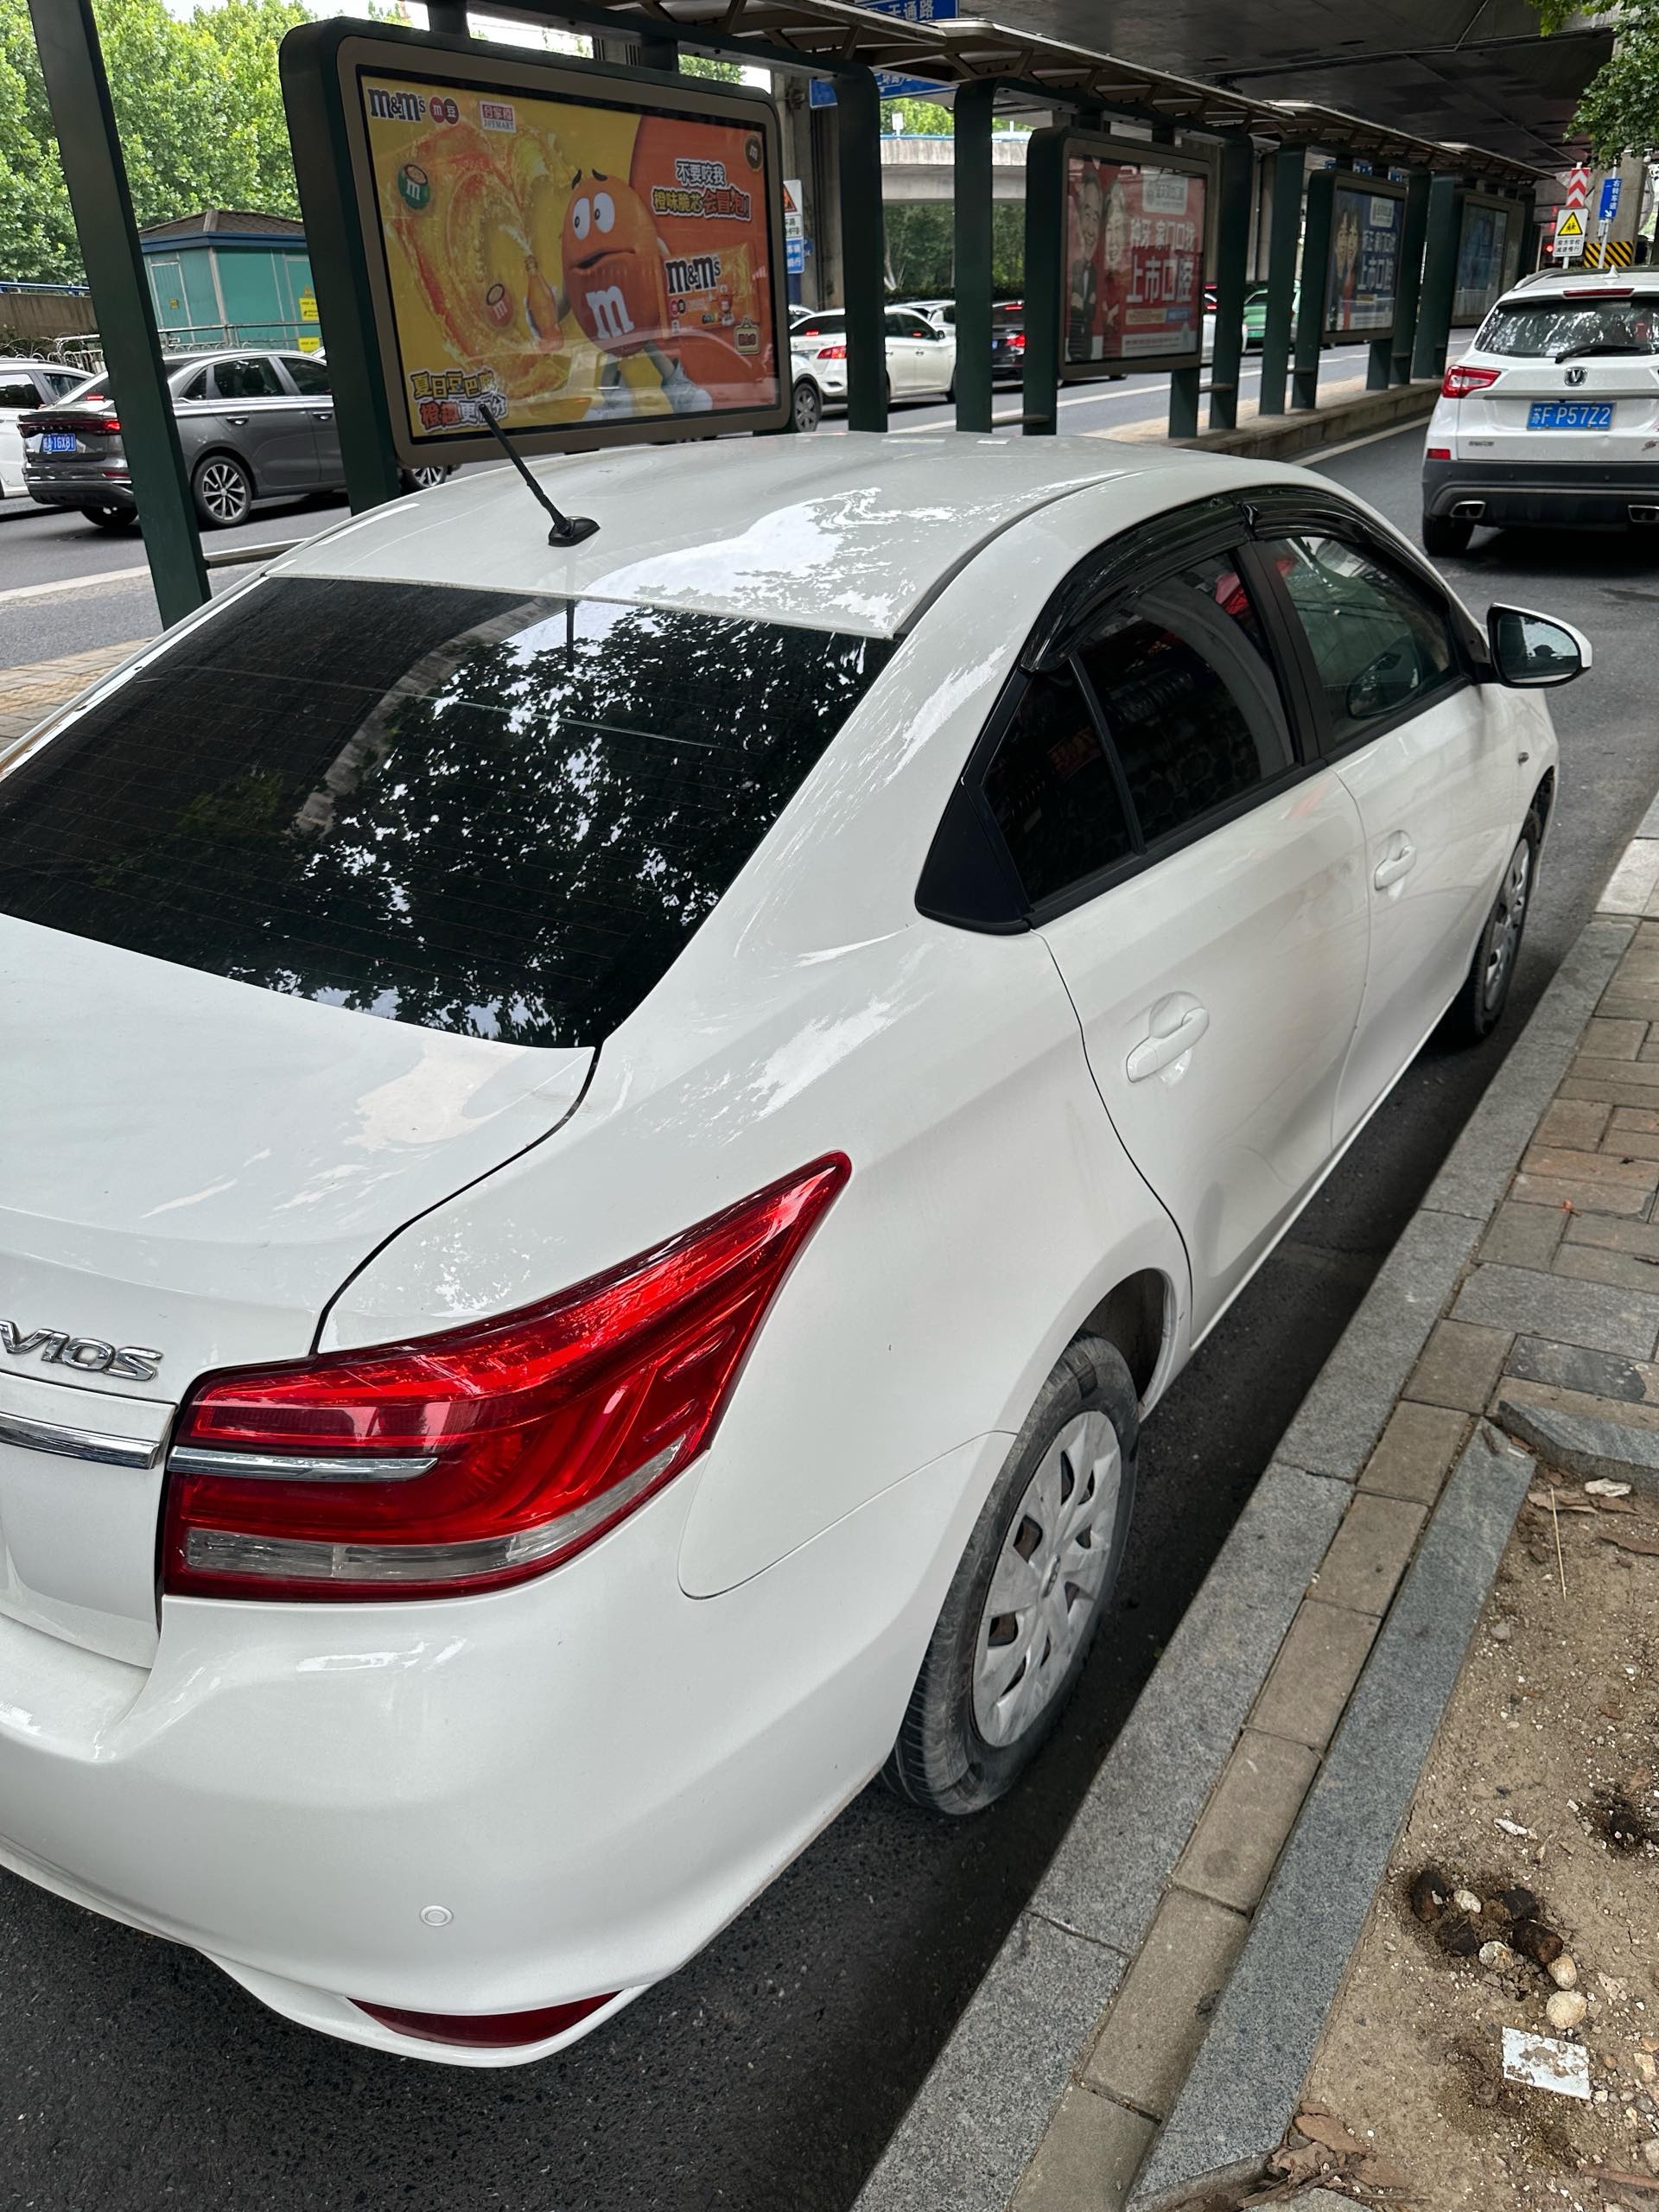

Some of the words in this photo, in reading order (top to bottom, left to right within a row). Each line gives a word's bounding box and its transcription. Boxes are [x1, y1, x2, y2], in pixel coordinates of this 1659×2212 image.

[676, 161, 726, 186] 不要咬我
[1126, 254, 1194, 303] 上市口腔
[0, 1319, 164, 1382] VIOS
